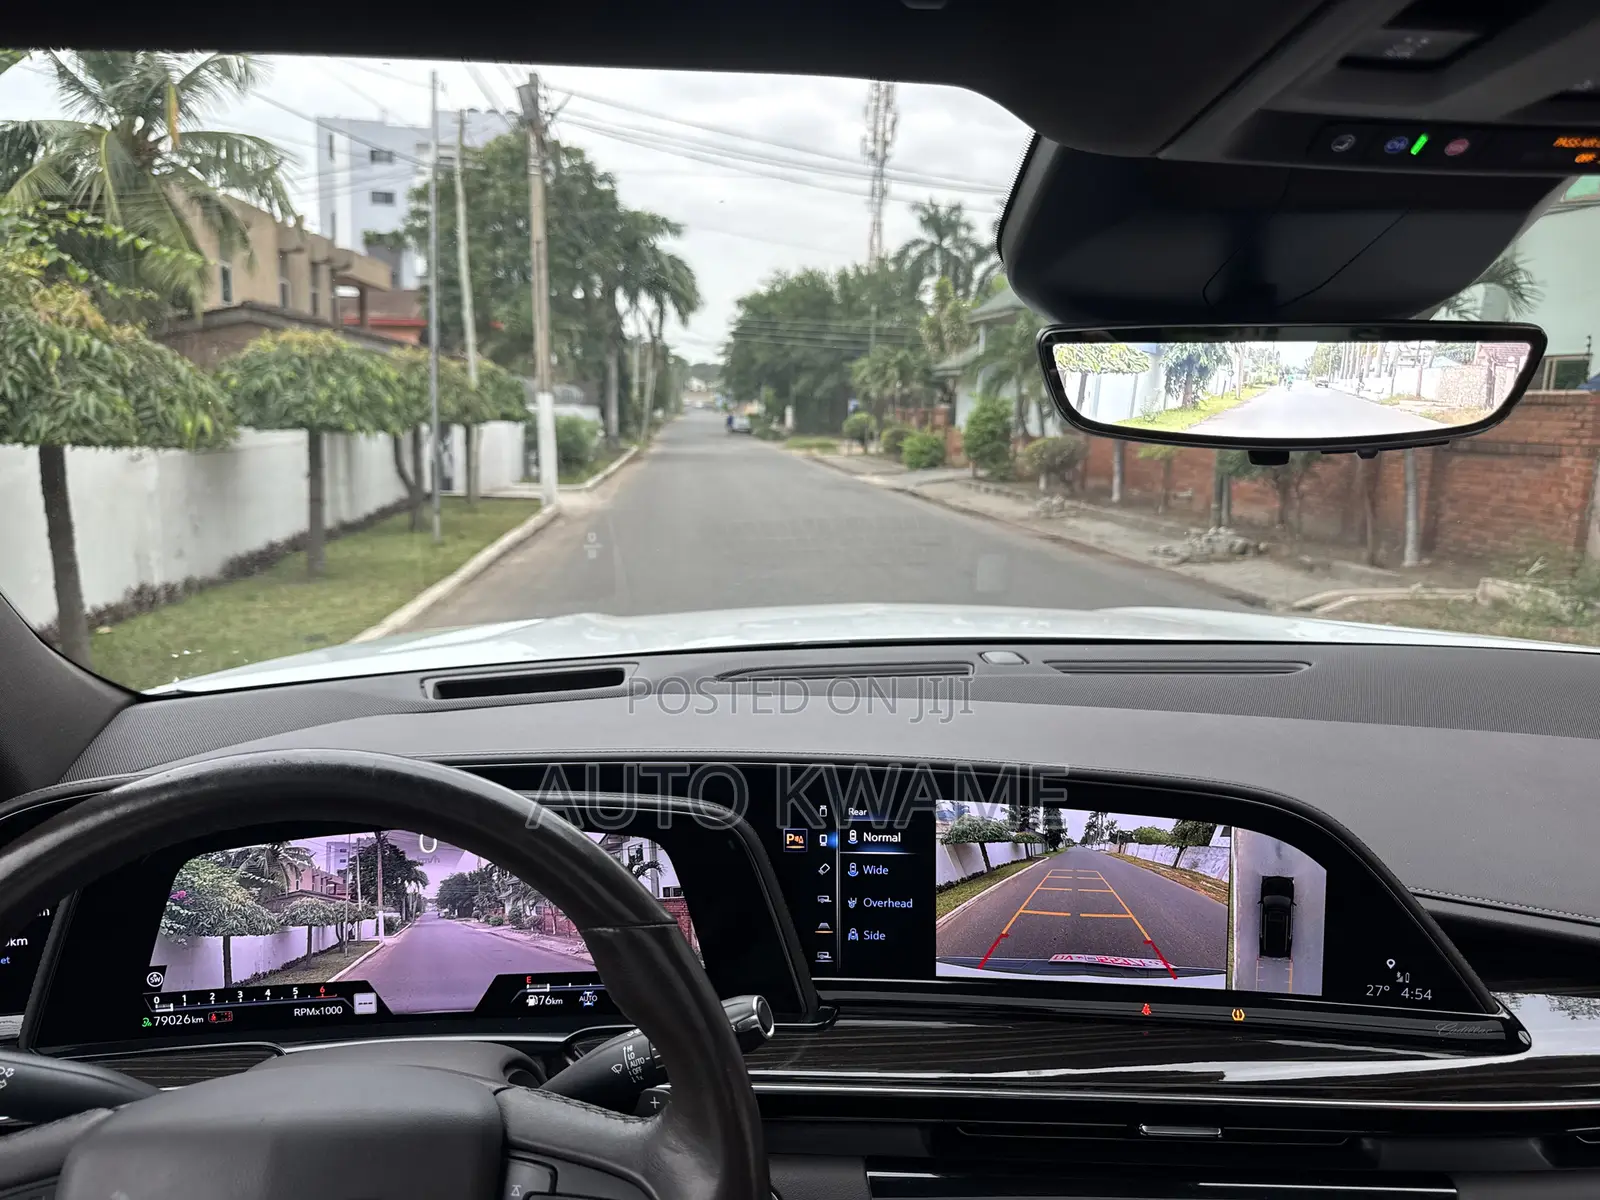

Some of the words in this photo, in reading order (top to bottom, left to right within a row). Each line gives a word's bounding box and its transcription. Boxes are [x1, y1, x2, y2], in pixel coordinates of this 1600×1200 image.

[848, 807, 867, 816] Rear
[863, 832, 901, 843] Normal
[863, 864, 889, 875] Wide
[863, 897, 913, 909] Overhead
[863, 930, 886, 941] Side
[526, 975, 532, 984] E
[153, 996, 160, 1004] 0
[181, 994, 187, 1002] 1
[209, 992, 215, 1000] 2
[237, 990, 243, 998] 3
[265, 988, 271, 996] 4
[292, 987, 298, 995] 5
[578, 995, 598, 1003] AUTO
[1400, 987, 1432, 1001] 4:54
[293, 1005, 343, 1017] RPMx1000
[1434, 1022, 1493, 1036] Cadillac
[627, 1052, 636, 1061] LO
[630, 1056, 645, 1069] AUTO
[632, 1066, 643, 1076] OFF
